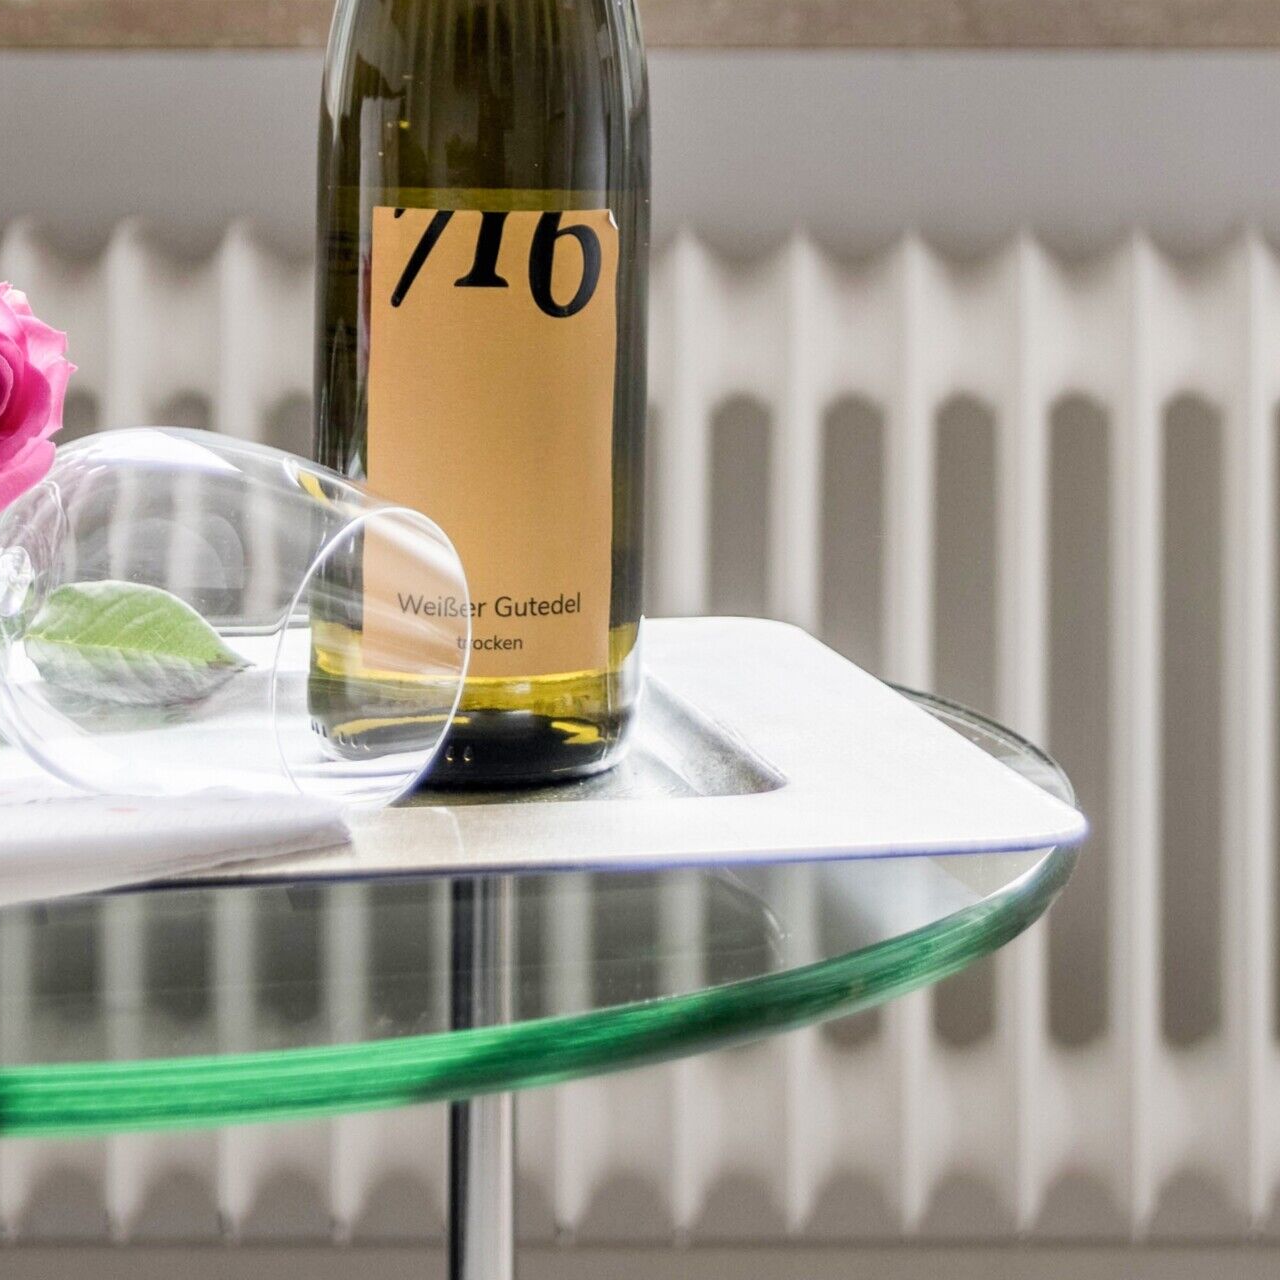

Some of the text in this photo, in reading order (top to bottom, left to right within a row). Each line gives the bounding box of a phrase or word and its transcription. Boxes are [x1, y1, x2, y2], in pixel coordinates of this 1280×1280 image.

[390, 209, 603, 318] 716
[397, 591, 582, 618] Weißer Gutedel
